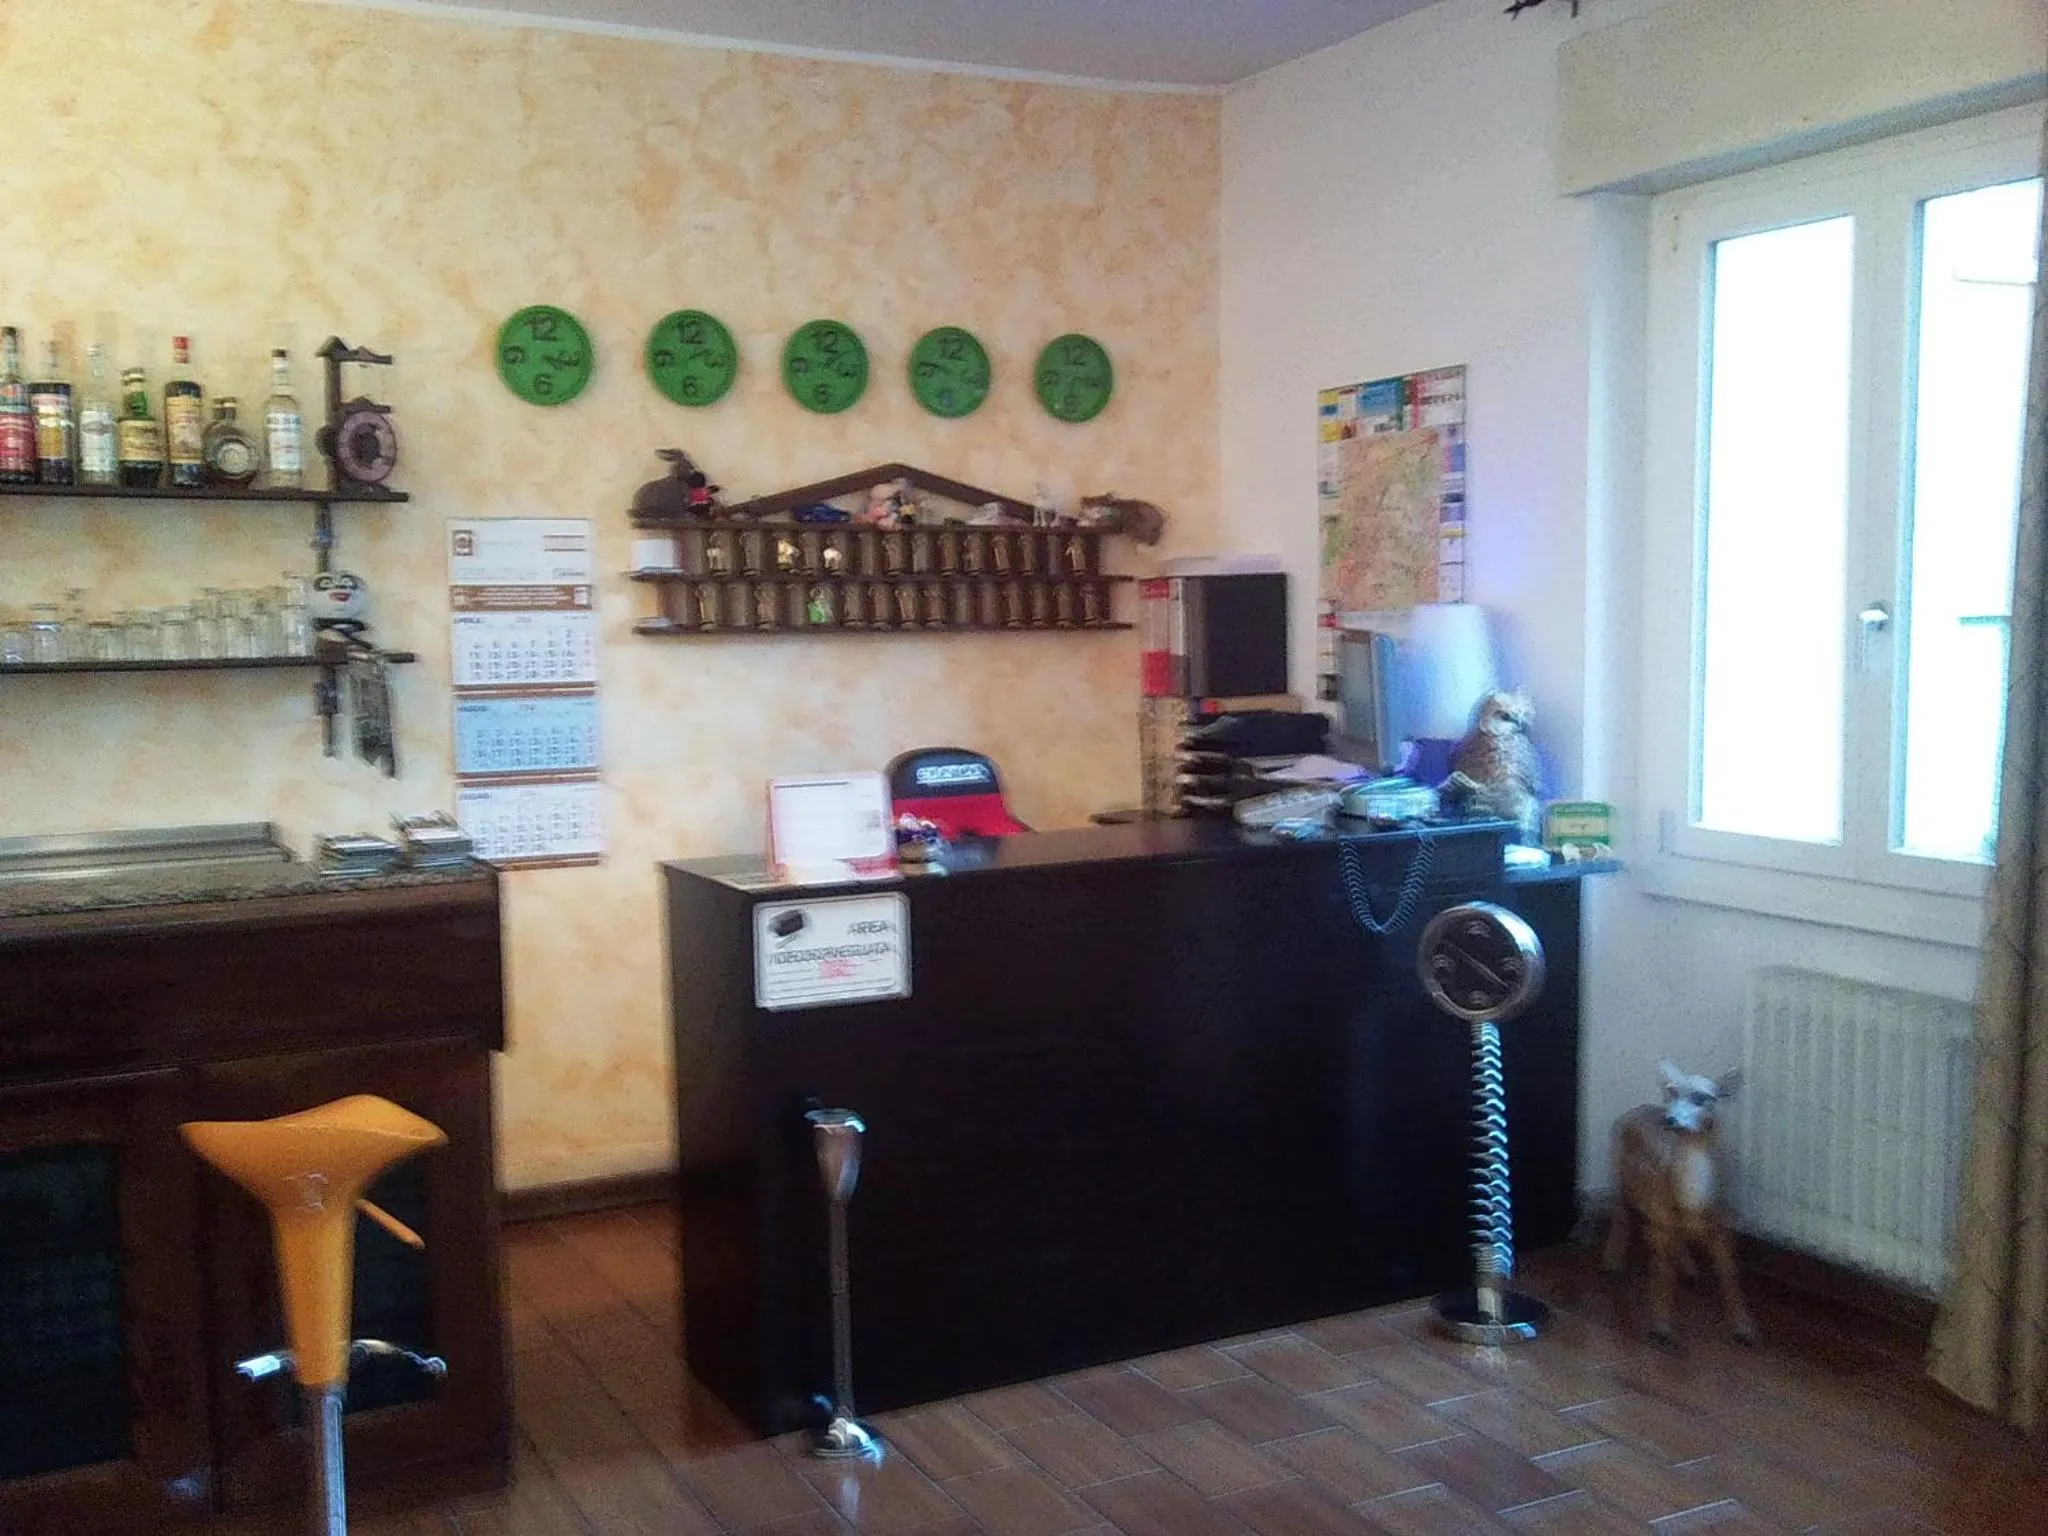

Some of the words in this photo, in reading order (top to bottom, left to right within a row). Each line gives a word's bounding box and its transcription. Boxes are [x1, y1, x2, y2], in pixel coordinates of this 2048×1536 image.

[677, 319, 706, 345] 12
[809, 330, 840, 355] 12
[1062, 344, 1087, 366] 12
